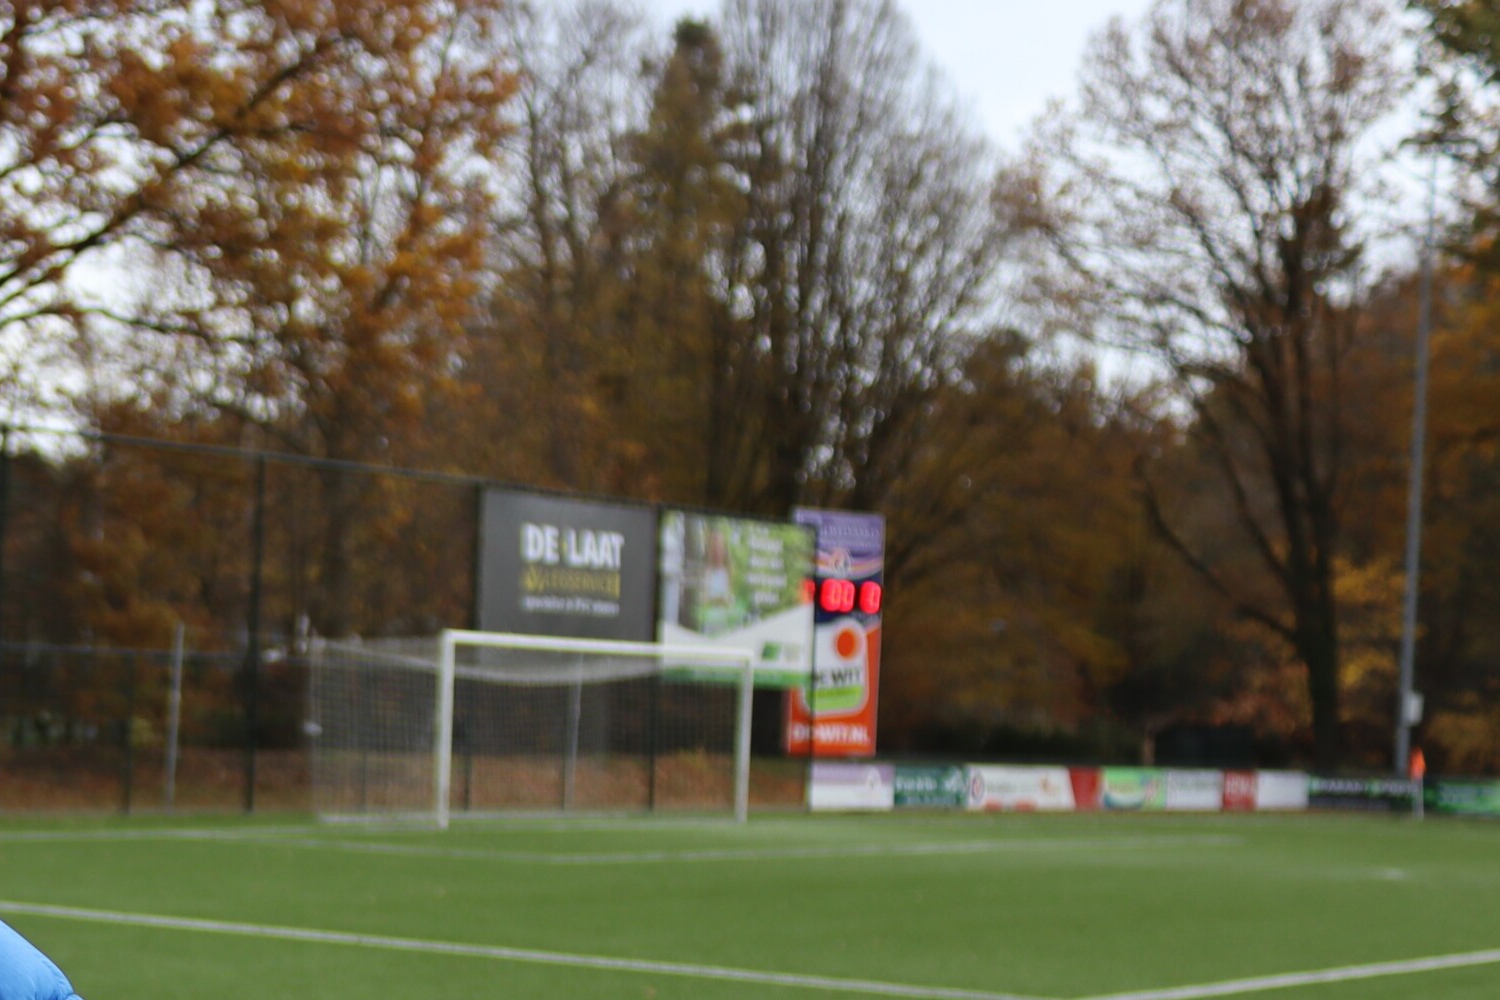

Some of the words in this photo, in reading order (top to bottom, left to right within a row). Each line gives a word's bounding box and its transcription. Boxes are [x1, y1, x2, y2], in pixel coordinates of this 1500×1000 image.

[522, 523, 560, 563] DE
[566, 528, 624, 570] LAAT
[860, 580, 882, 615] 0
[830, 667, 862, 686] WIT
